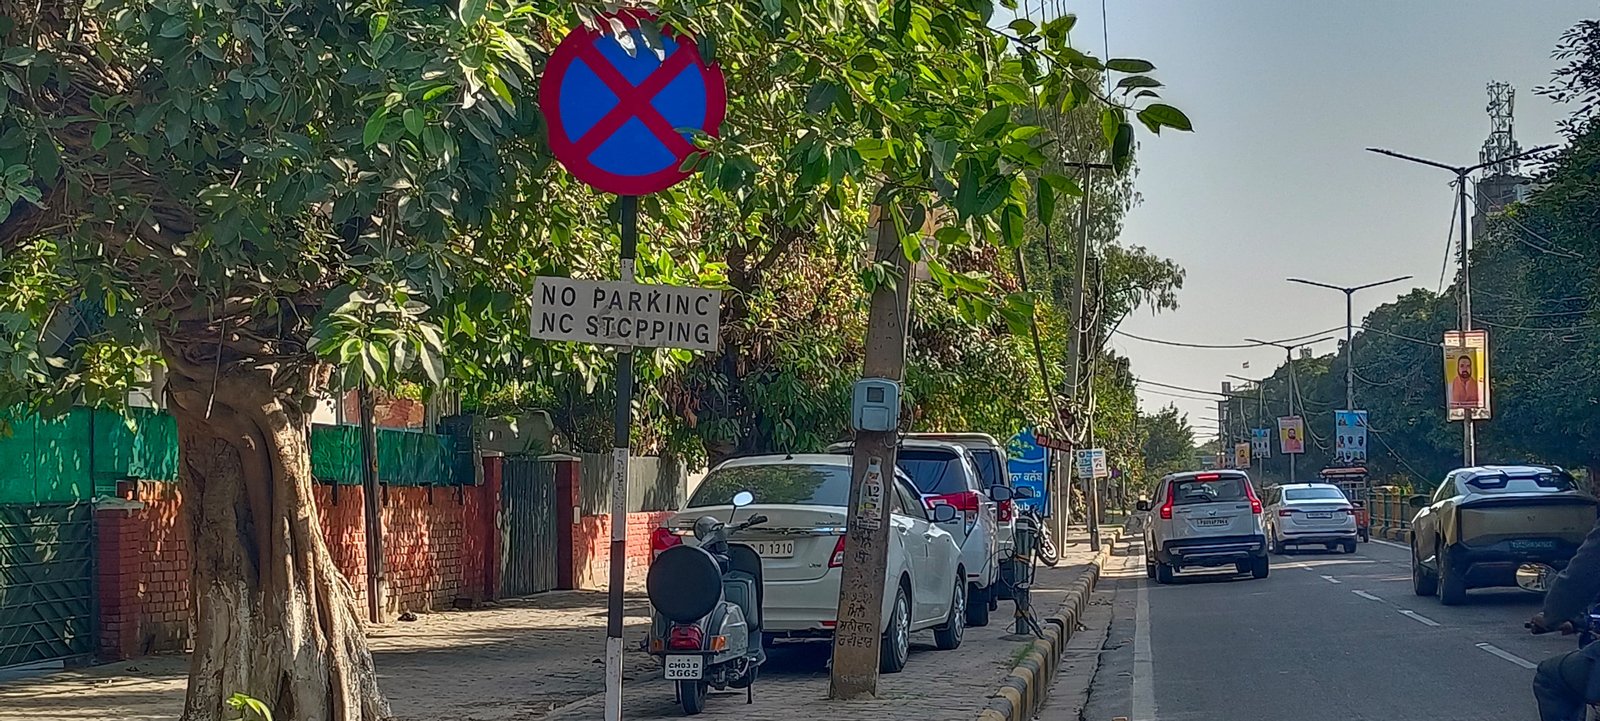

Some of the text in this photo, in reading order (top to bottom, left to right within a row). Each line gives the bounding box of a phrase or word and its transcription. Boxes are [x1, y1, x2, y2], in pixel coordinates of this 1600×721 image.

[542, 284, 576, 307] NO
[769, 543, 793, 554] 1310
[668, 669, 699, 678] 3665
